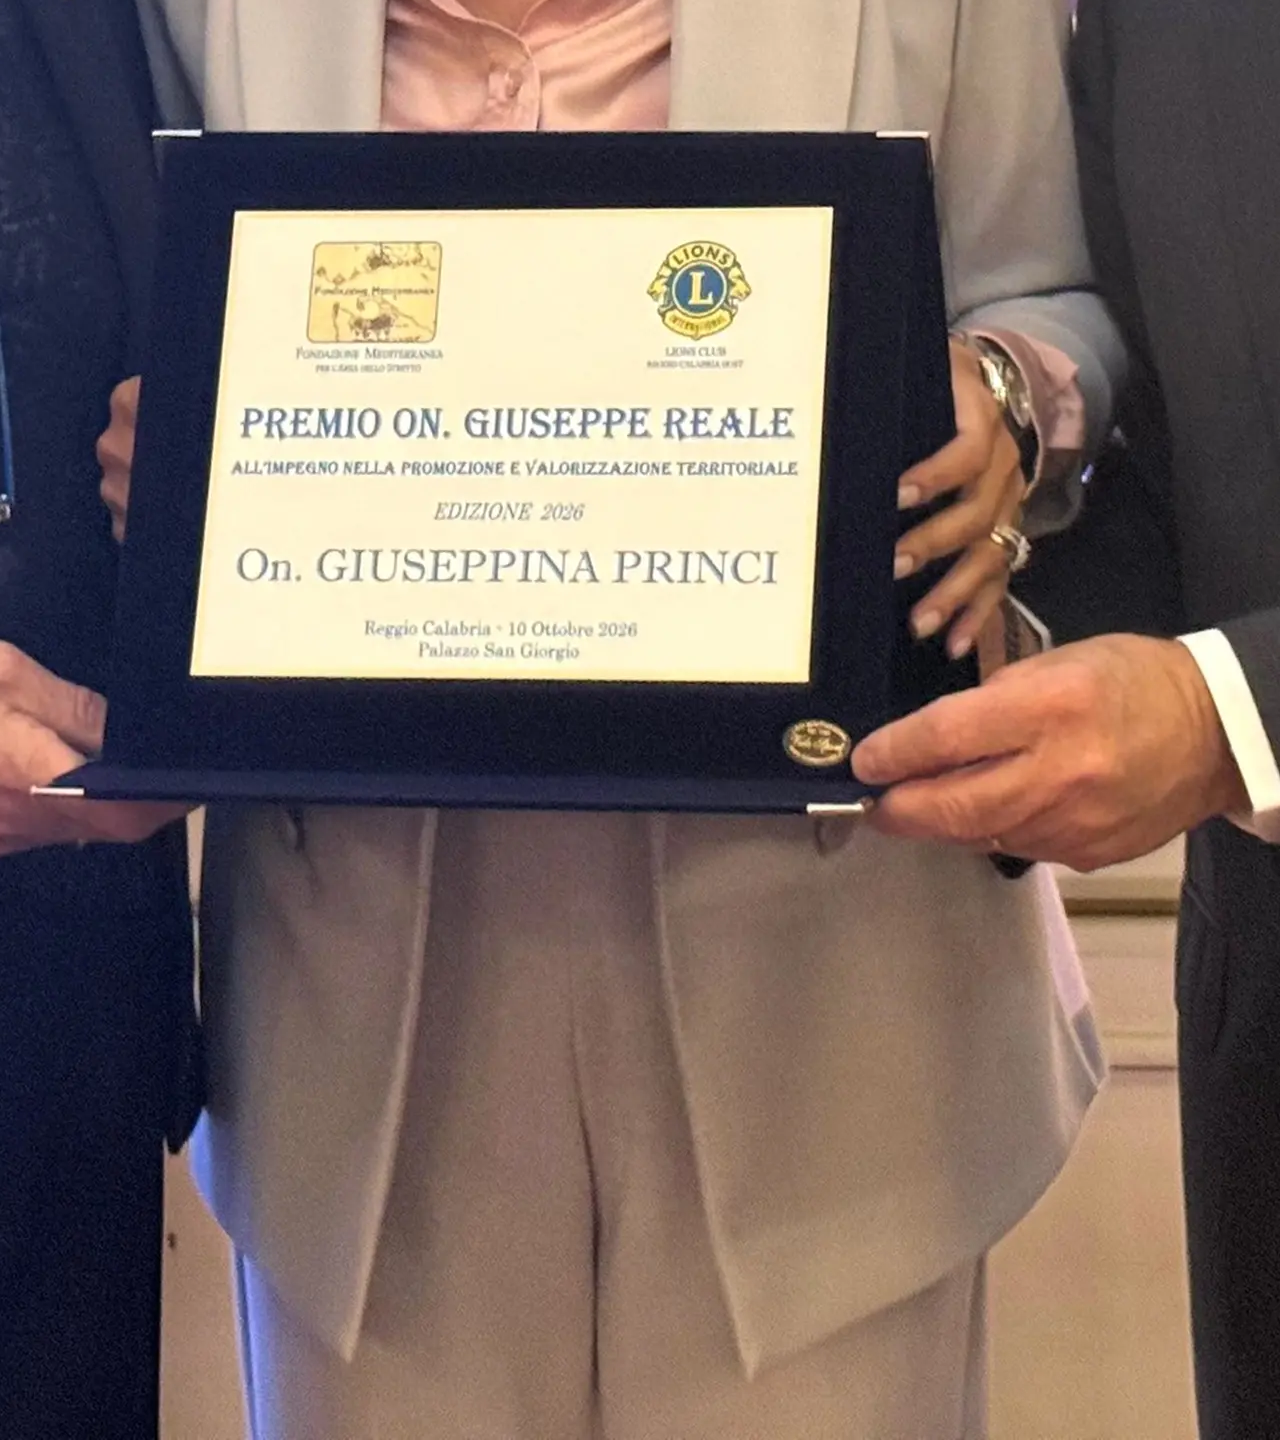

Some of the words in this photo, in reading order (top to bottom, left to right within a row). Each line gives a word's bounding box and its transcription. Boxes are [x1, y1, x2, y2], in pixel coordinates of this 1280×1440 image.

[672, 244, 731, 266] LIONS
[687, 270, 714, 306] L
[240, 407, 382, 441] PREMIO
[392, 407, 452, 440] ON.
[463, 407, 653, 440] GIUSEPPE
[663, 407, 796, 441] REALE
[231, 459, 339, 476] ALL'IMPEGNO
[343, 461, 395, 476] NELLA
[401, 461, 506, 476] PROMOZIONE
[510, 461, 520, 476] E
[525, 458, 673, 476] VALORIZZAZIONE
[677, 461, 799, 476] TERRITORIALE
[433, 501, 534, 521] EDIZIONE
[540, 502, 586, 521] 2026
[236, 547, 303, 582] On.
[316, 548, 600, 583] GIUSEPPINA
[612, 549, 779, 585] PRINCI
[363, 619, 418, 639] Reggio
[422, 619, 491, 636] Calabria
[508, 621, 527, 637] 10
[531, 620, 594, 637] Ottobre
[597, 622, 638, 638] 2026
[418, 641, 480, 658] Palazzo
[483, 642, 516, 658] San
[520, 642, 580, 663] Giorgio
